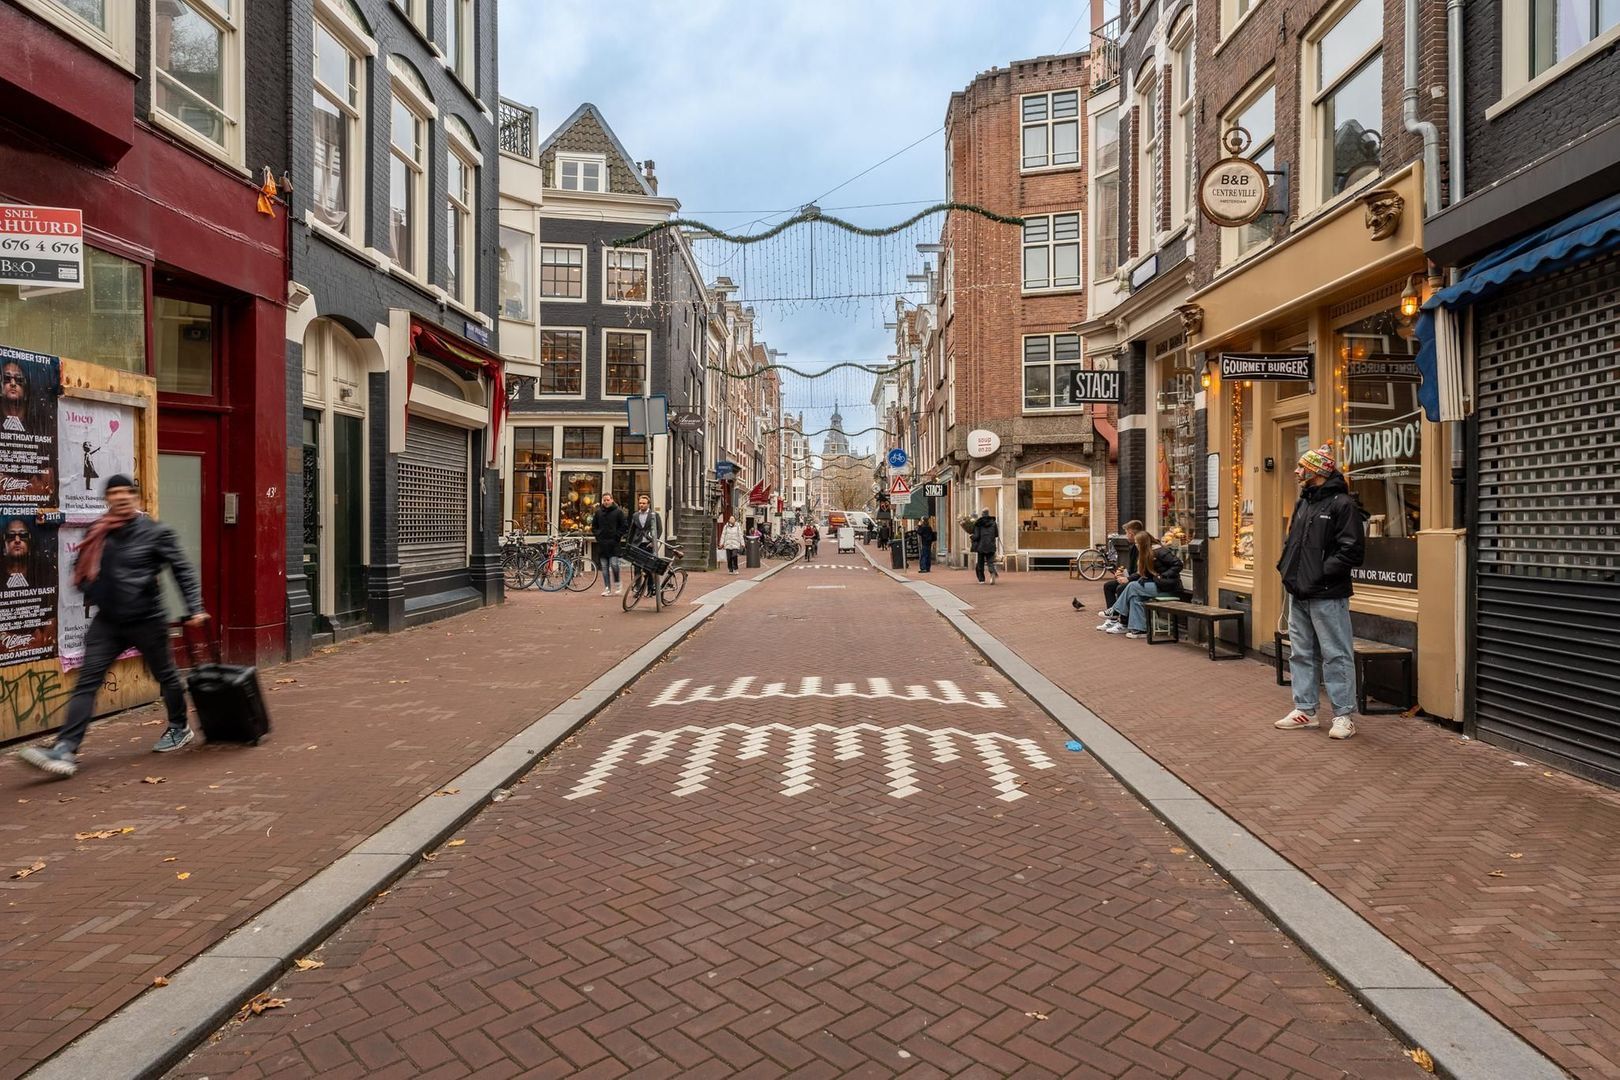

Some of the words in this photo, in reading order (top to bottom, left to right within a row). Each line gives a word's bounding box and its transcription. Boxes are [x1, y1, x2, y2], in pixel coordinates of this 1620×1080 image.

[1221, 174, 1249, 185] B&B
[5, 209, 37, 219] SNEL
[0, 220, 77, 234] HUURD
[2, 238, 29, 251] 676
[36, 241, 45, 252] 4
[52, 242, 79, 254] 676
[2, 260, 35, 273] B&O
[35, 355, 50, 365] 13TH
[1223, 359, 1266, 374] GOURMET
[1268, 360, 1308, 375] BURGERS
[1076, 373, 1119, 398] STACH
[1, 433, 33, 442] BIRTHDAY
[1336, 420, 1421, 468] LOMBARDO'
[925, 485, 943, 496] STACH
[1359, 570, 1365, 579] IN
[1367, 570, 1376, 580] OR
[1378, 571, 1396, 581] TAKE
[1397, 573, 1413, 583] OUT
[4, 588, 38, 598] BIRTHDAY
[15, 646, 53, 658] AMSTERDAM
